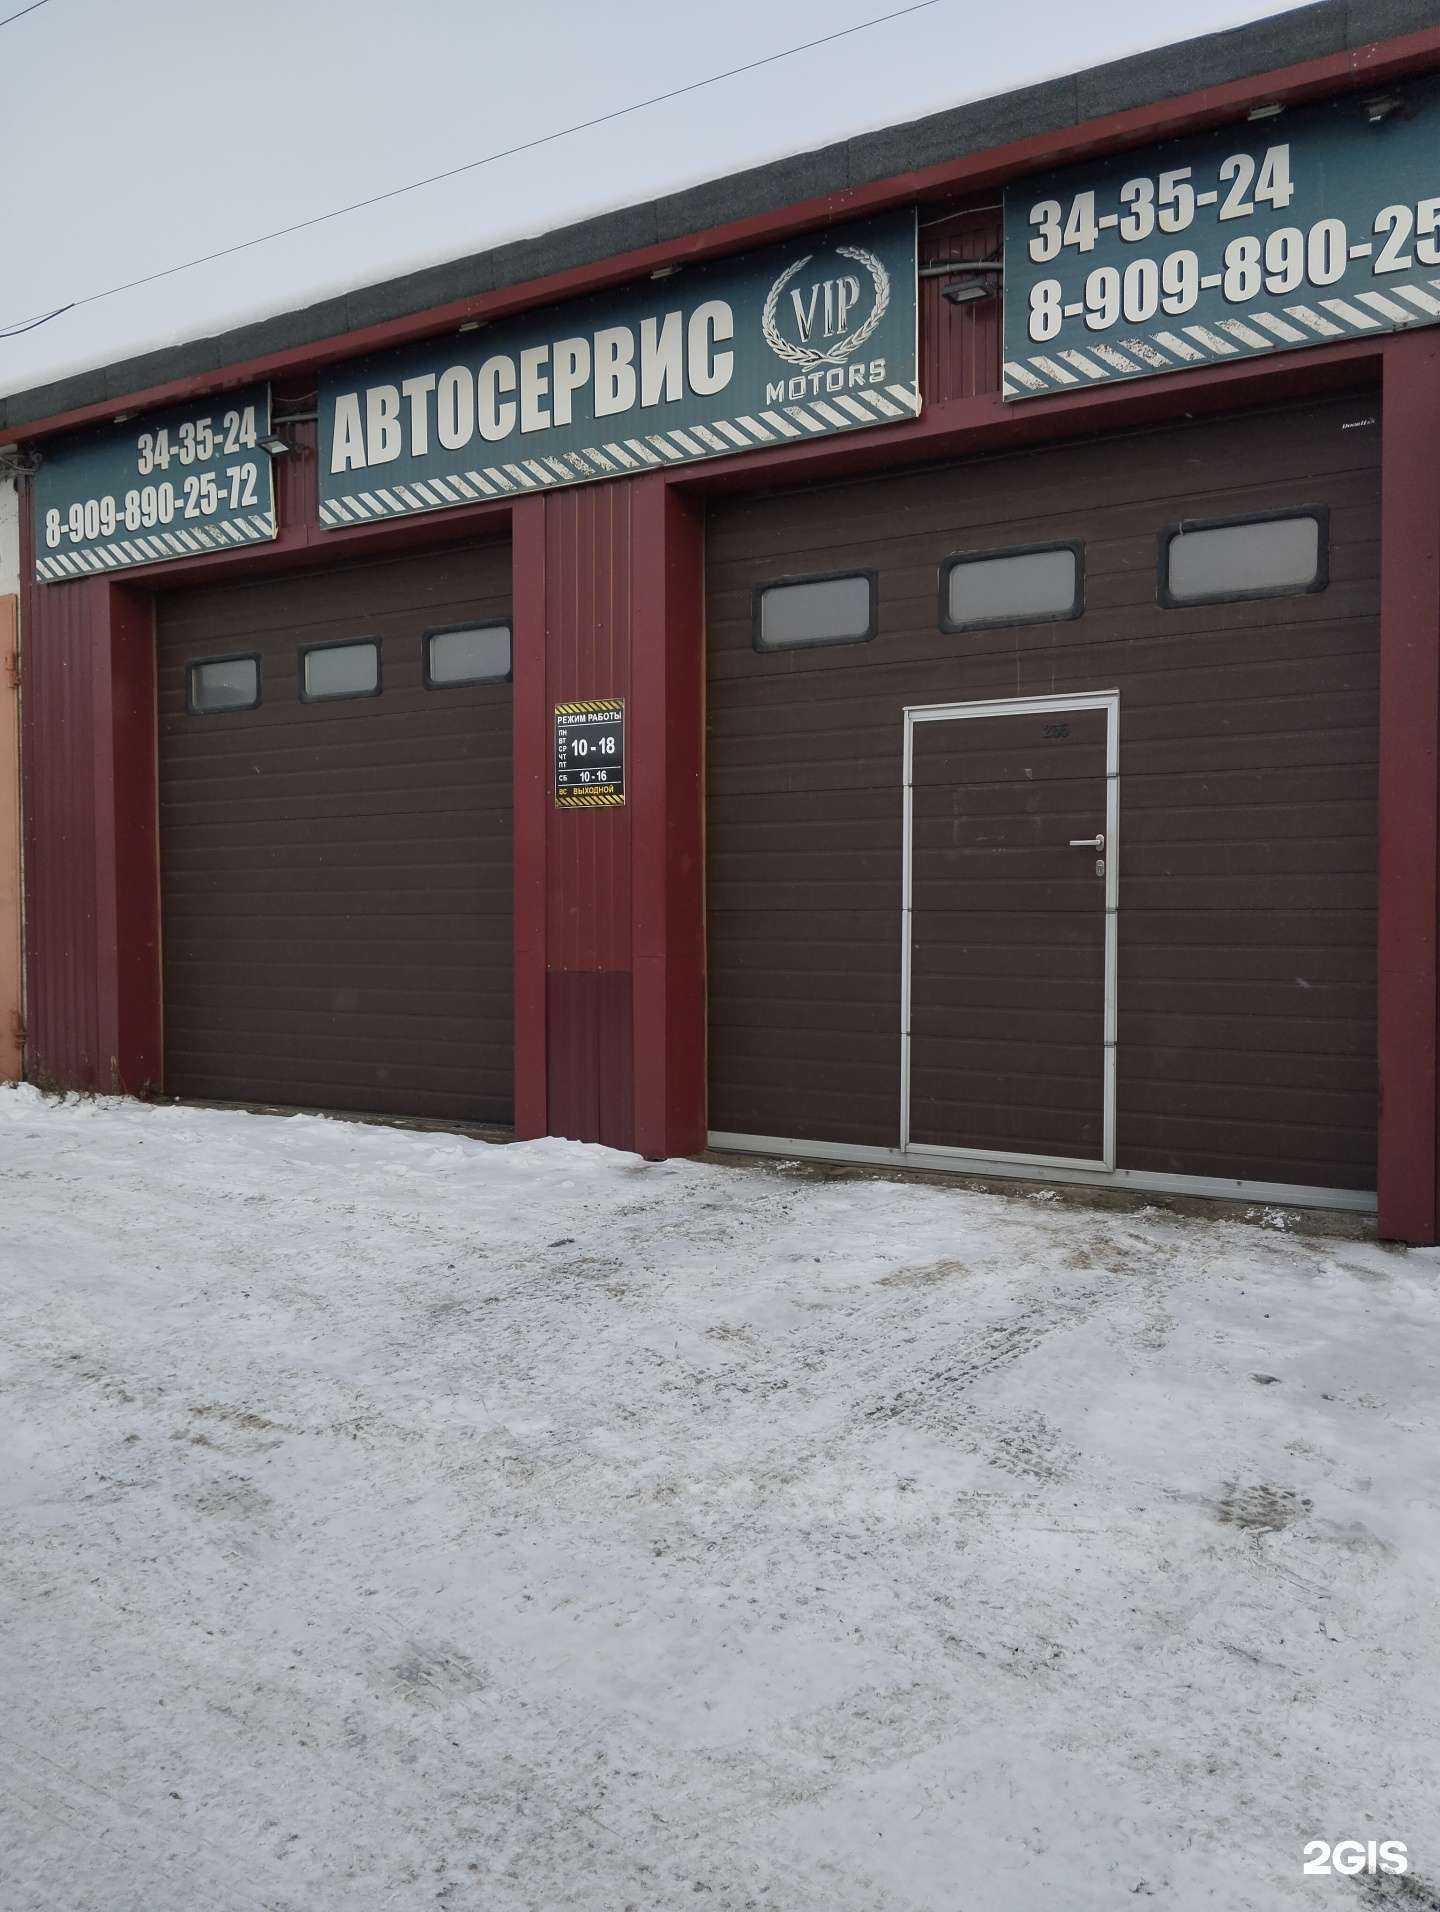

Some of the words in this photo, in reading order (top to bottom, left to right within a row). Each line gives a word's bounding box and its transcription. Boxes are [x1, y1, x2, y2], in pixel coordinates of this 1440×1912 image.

[1029, 143, 1295, 263] 34-35-24
[790, 274, 861, 343] VIP
[330, 299, 734, 474] АВТОСЕРВИС
[766, 358, 886, 406] MOTORS
[137, 406, 257, 475] 34-35-24
[45, 462, 258, 549] 8-909-890-25-72
[557, 714, 586, 725] РЕЖИМ
[587, 711, 622, 722] РАБОТЫ
[558, 729, 568, 737] ПН
[558, 737, 567, 745] ВТ
[558, 745, 567, 753] СР
[558, 753, 567, 761] ЧТ
[558, 774, 568, 782] СБ
[572, 784, 614, 796] ВЫХОДНОЙ
